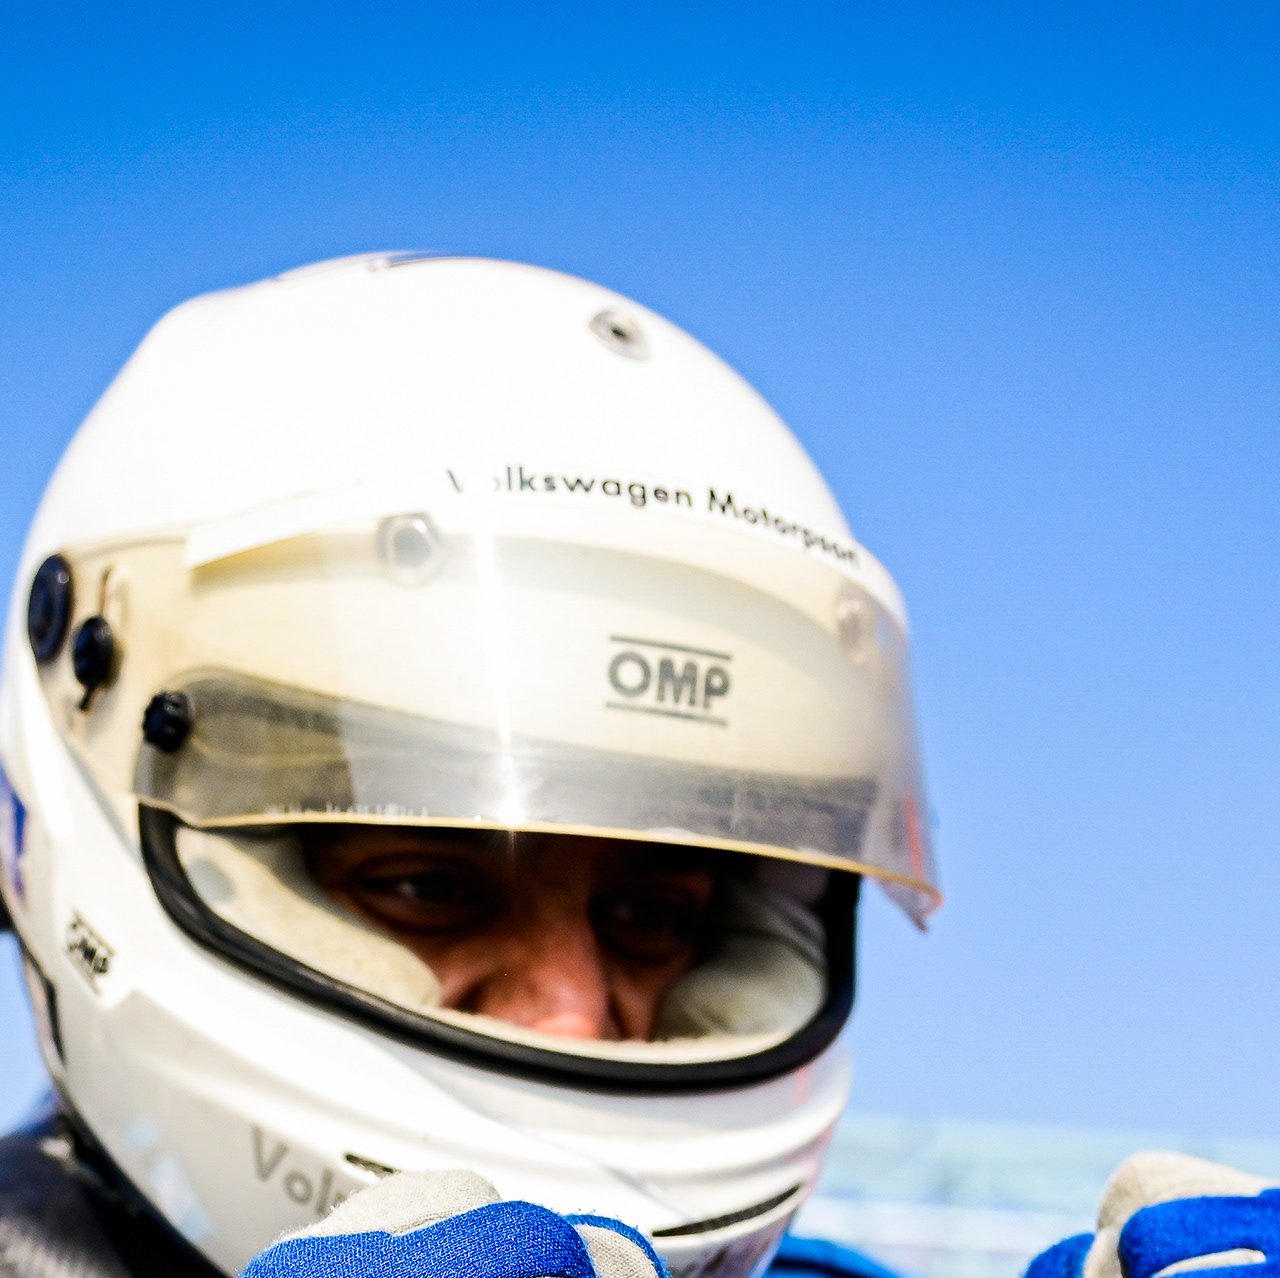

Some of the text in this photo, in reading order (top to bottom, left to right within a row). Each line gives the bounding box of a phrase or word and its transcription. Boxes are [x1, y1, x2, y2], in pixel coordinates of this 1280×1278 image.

[447, 466, 693, 507] Vlkswagen
[607, 650, 732, 710] OMP
[251, 1123, 348, 1218] Vol
